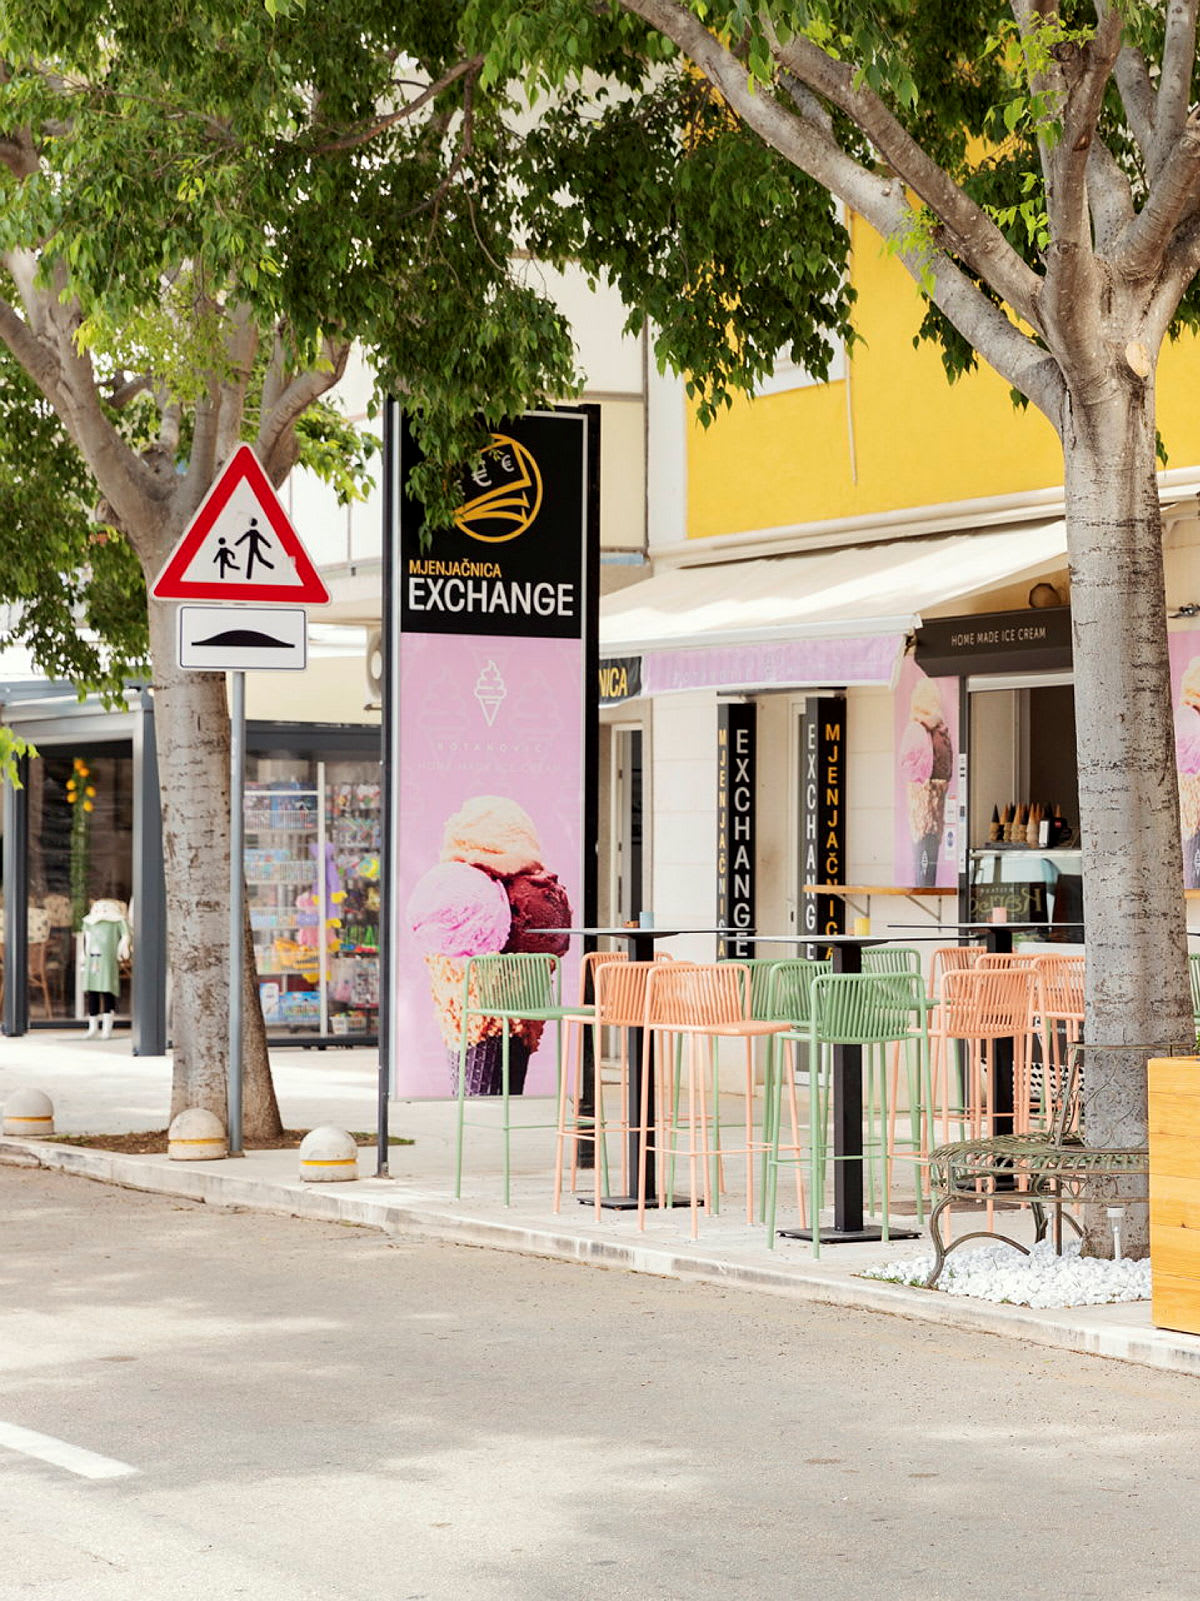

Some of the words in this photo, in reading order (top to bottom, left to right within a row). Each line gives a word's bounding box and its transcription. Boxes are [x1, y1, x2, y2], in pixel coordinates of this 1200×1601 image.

[409, 558, 502, 578] MJENJAČNICA
[409, 577, 574, 616] EXCHANGE
[951, 632, 975, 646] HOME
[977, 630, 999, 644] MADE
[1001, 629, 1015, 642] ICE
[1017, 627, 1047, 641] CREAM
[733, 729, 751, 957] EXCHANGE
